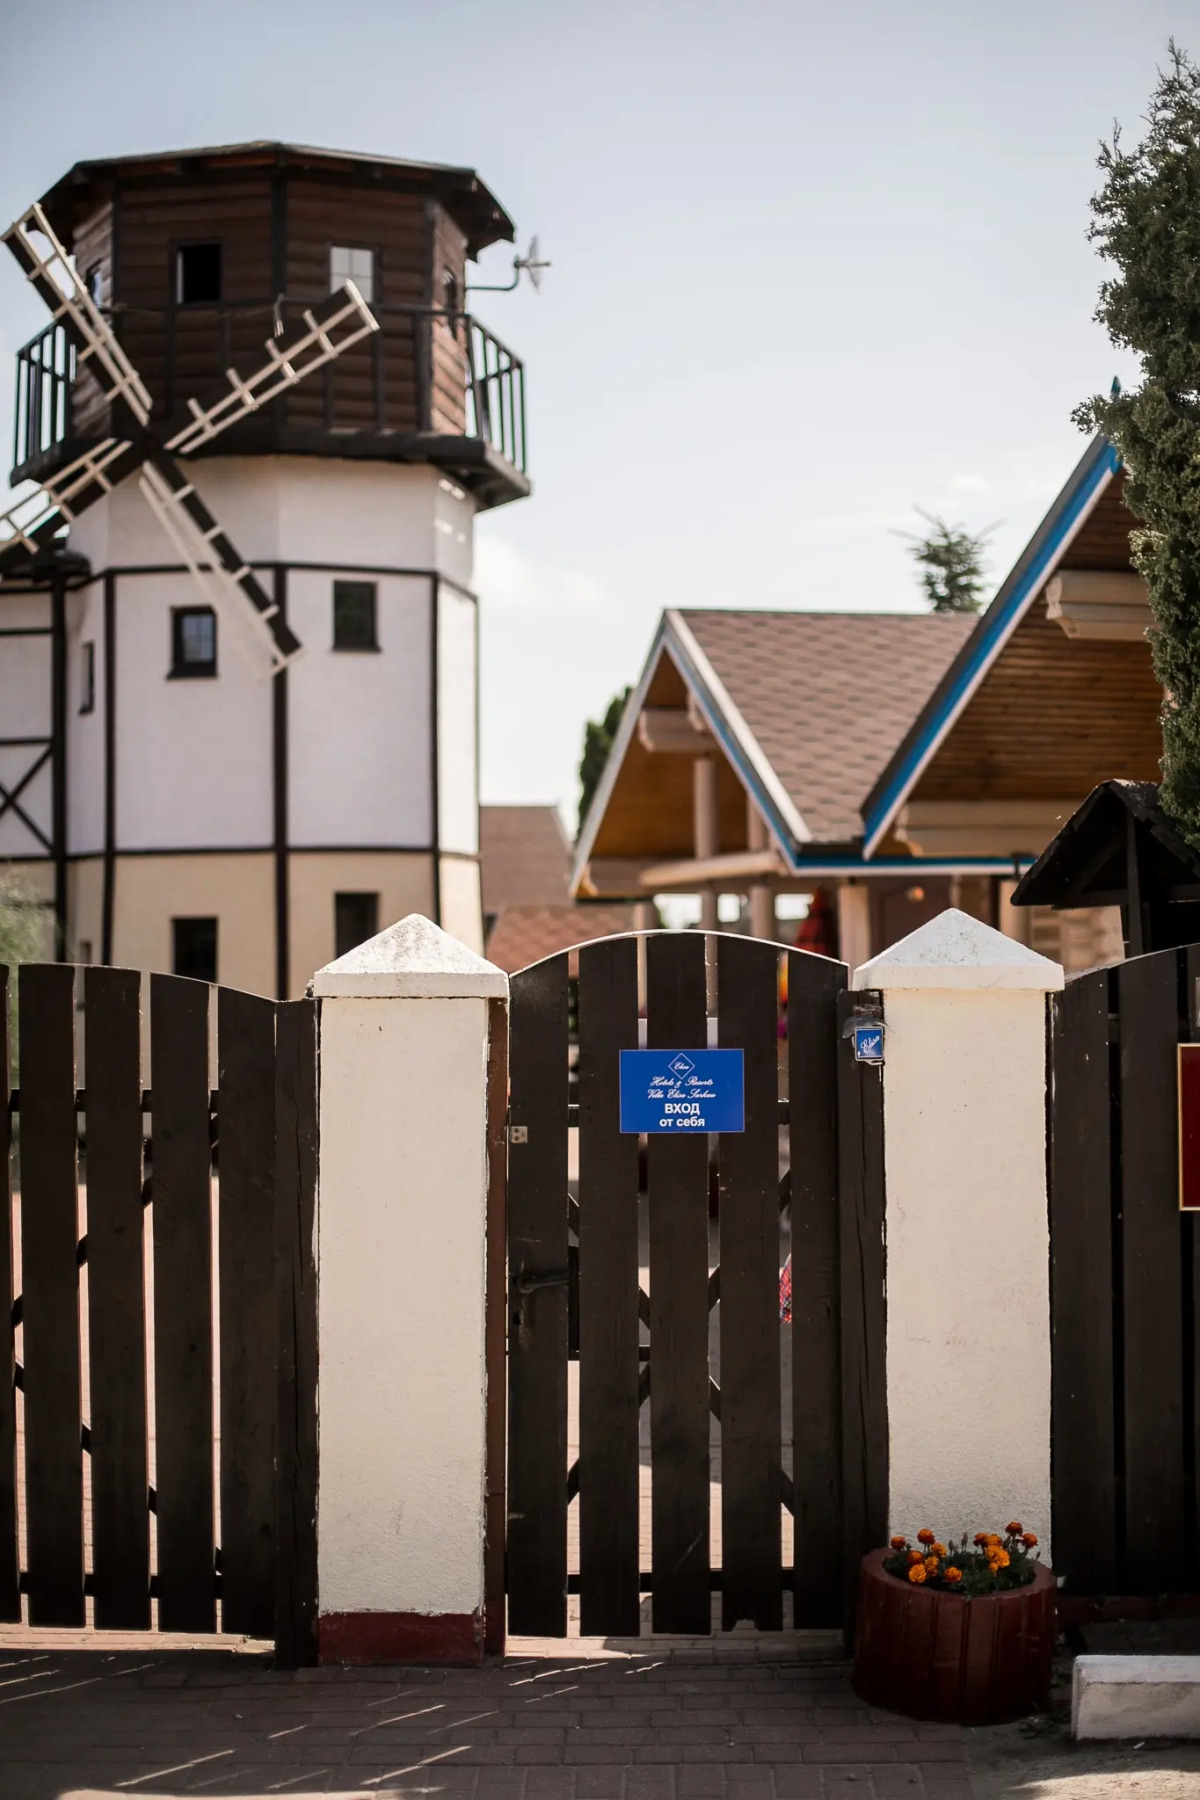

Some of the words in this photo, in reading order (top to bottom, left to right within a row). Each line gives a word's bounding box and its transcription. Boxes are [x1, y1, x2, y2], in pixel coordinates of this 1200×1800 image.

[650, 1076, 674, 1086] Hotels
[685, 1076, 713, 1086] Resorts
[648, 1089, 664, 1098] Villa
[667, 1089, 686, 1098] Elisa
[664, 1103, 700, 1115] ВХОД
[659, 1119, 673, 1127] от
[676, 1116, 705, 1127] себя
